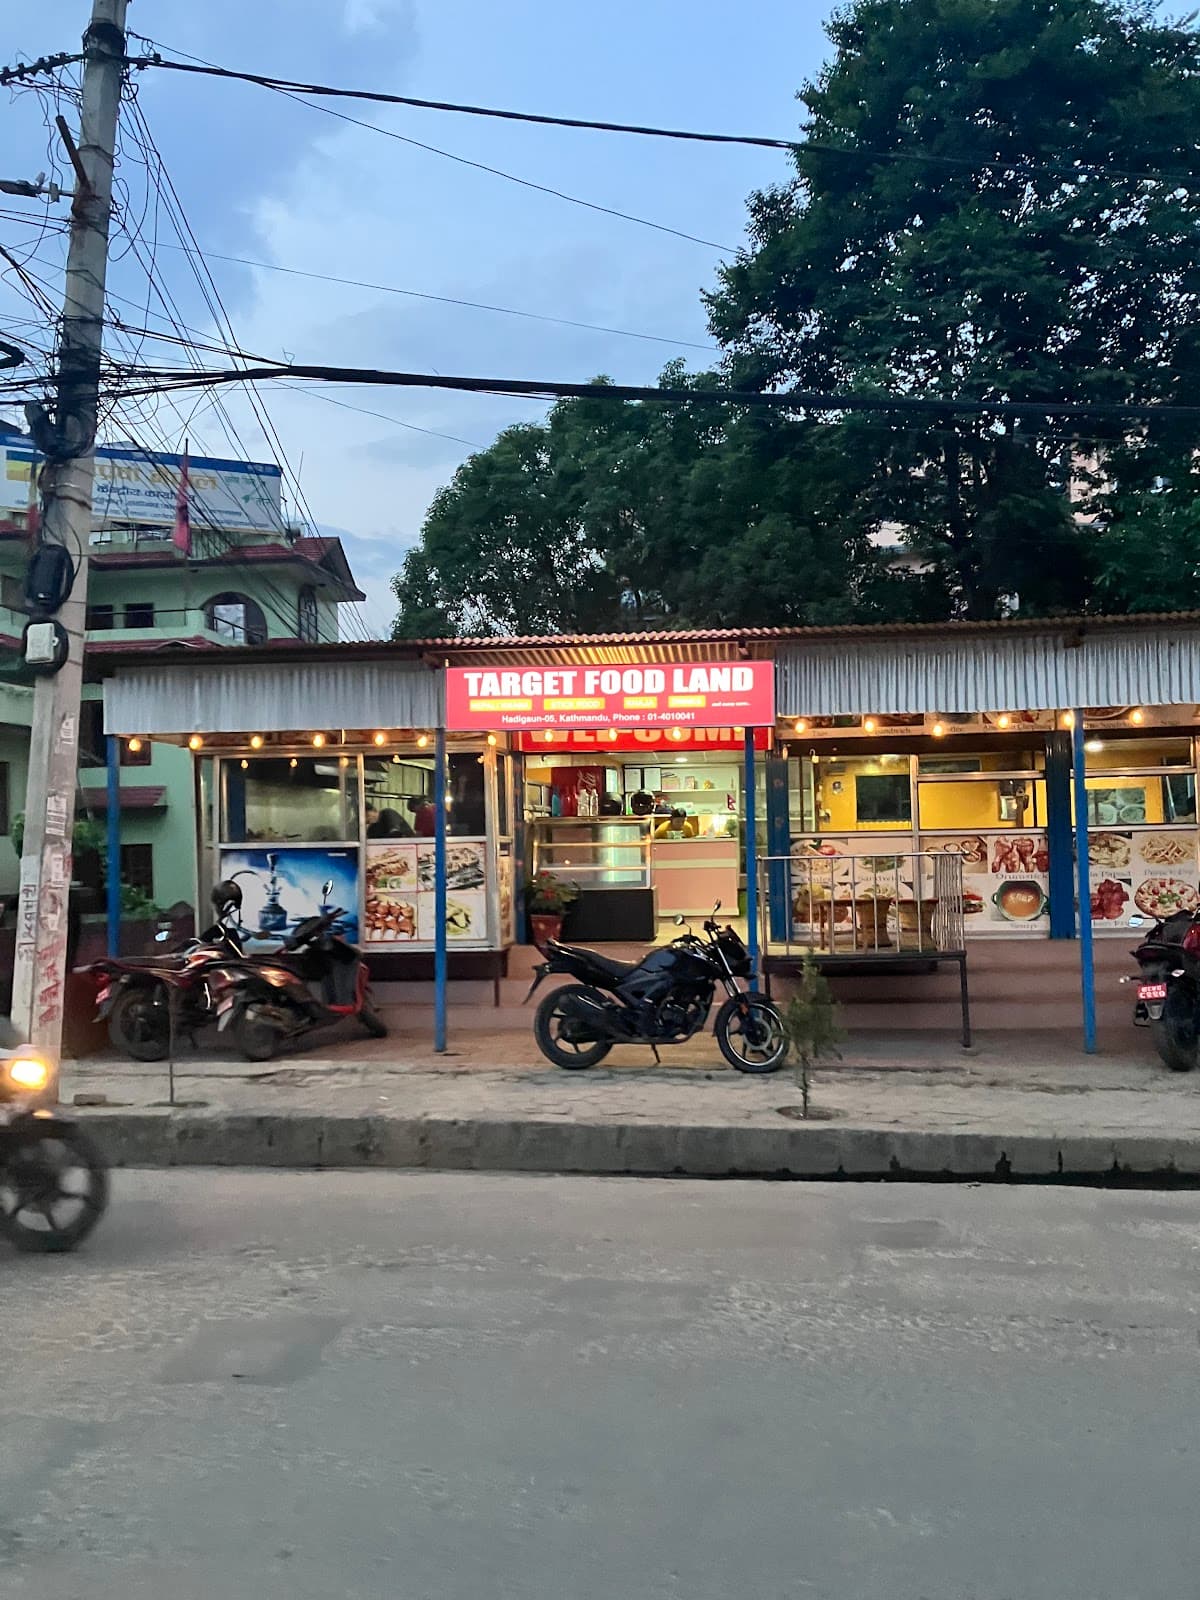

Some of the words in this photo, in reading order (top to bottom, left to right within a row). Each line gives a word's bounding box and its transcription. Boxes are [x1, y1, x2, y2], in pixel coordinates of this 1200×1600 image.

[464, 671, 577, 697] TARGET
[585, 669, 664, 695] FOOD
[673, 667, 754, 693] LAND
[559, 713, 610, 723] Kathmandu,
[613, 712, 640, 722] Phone
[647, 712, 695, 721] 01-4010041
